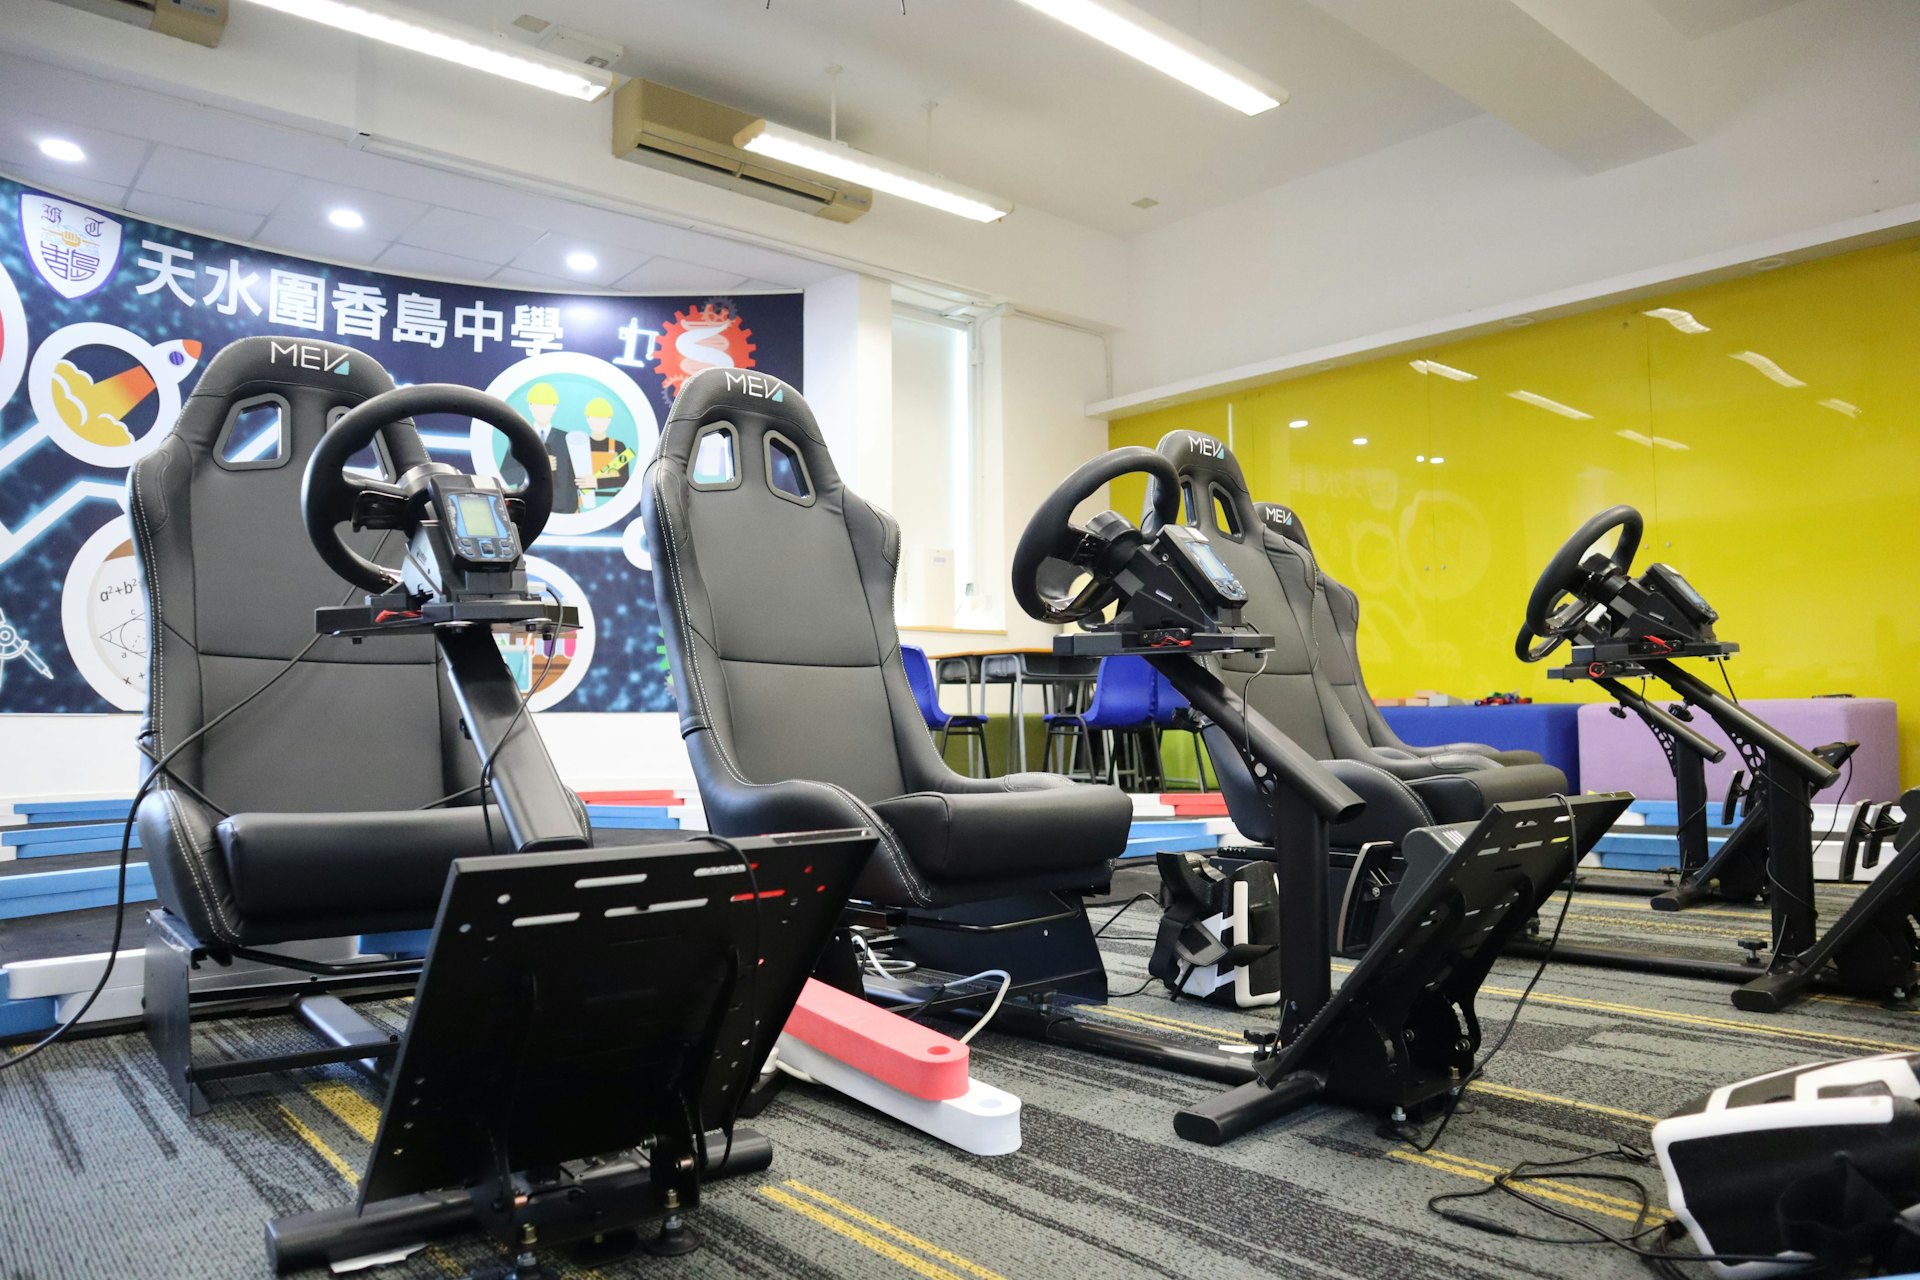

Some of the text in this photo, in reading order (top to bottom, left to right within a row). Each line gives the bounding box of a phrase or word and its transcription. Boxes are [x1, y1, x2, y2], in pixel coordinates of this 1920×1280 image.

[135, 239, 564, 357] 天水圍香島中學
